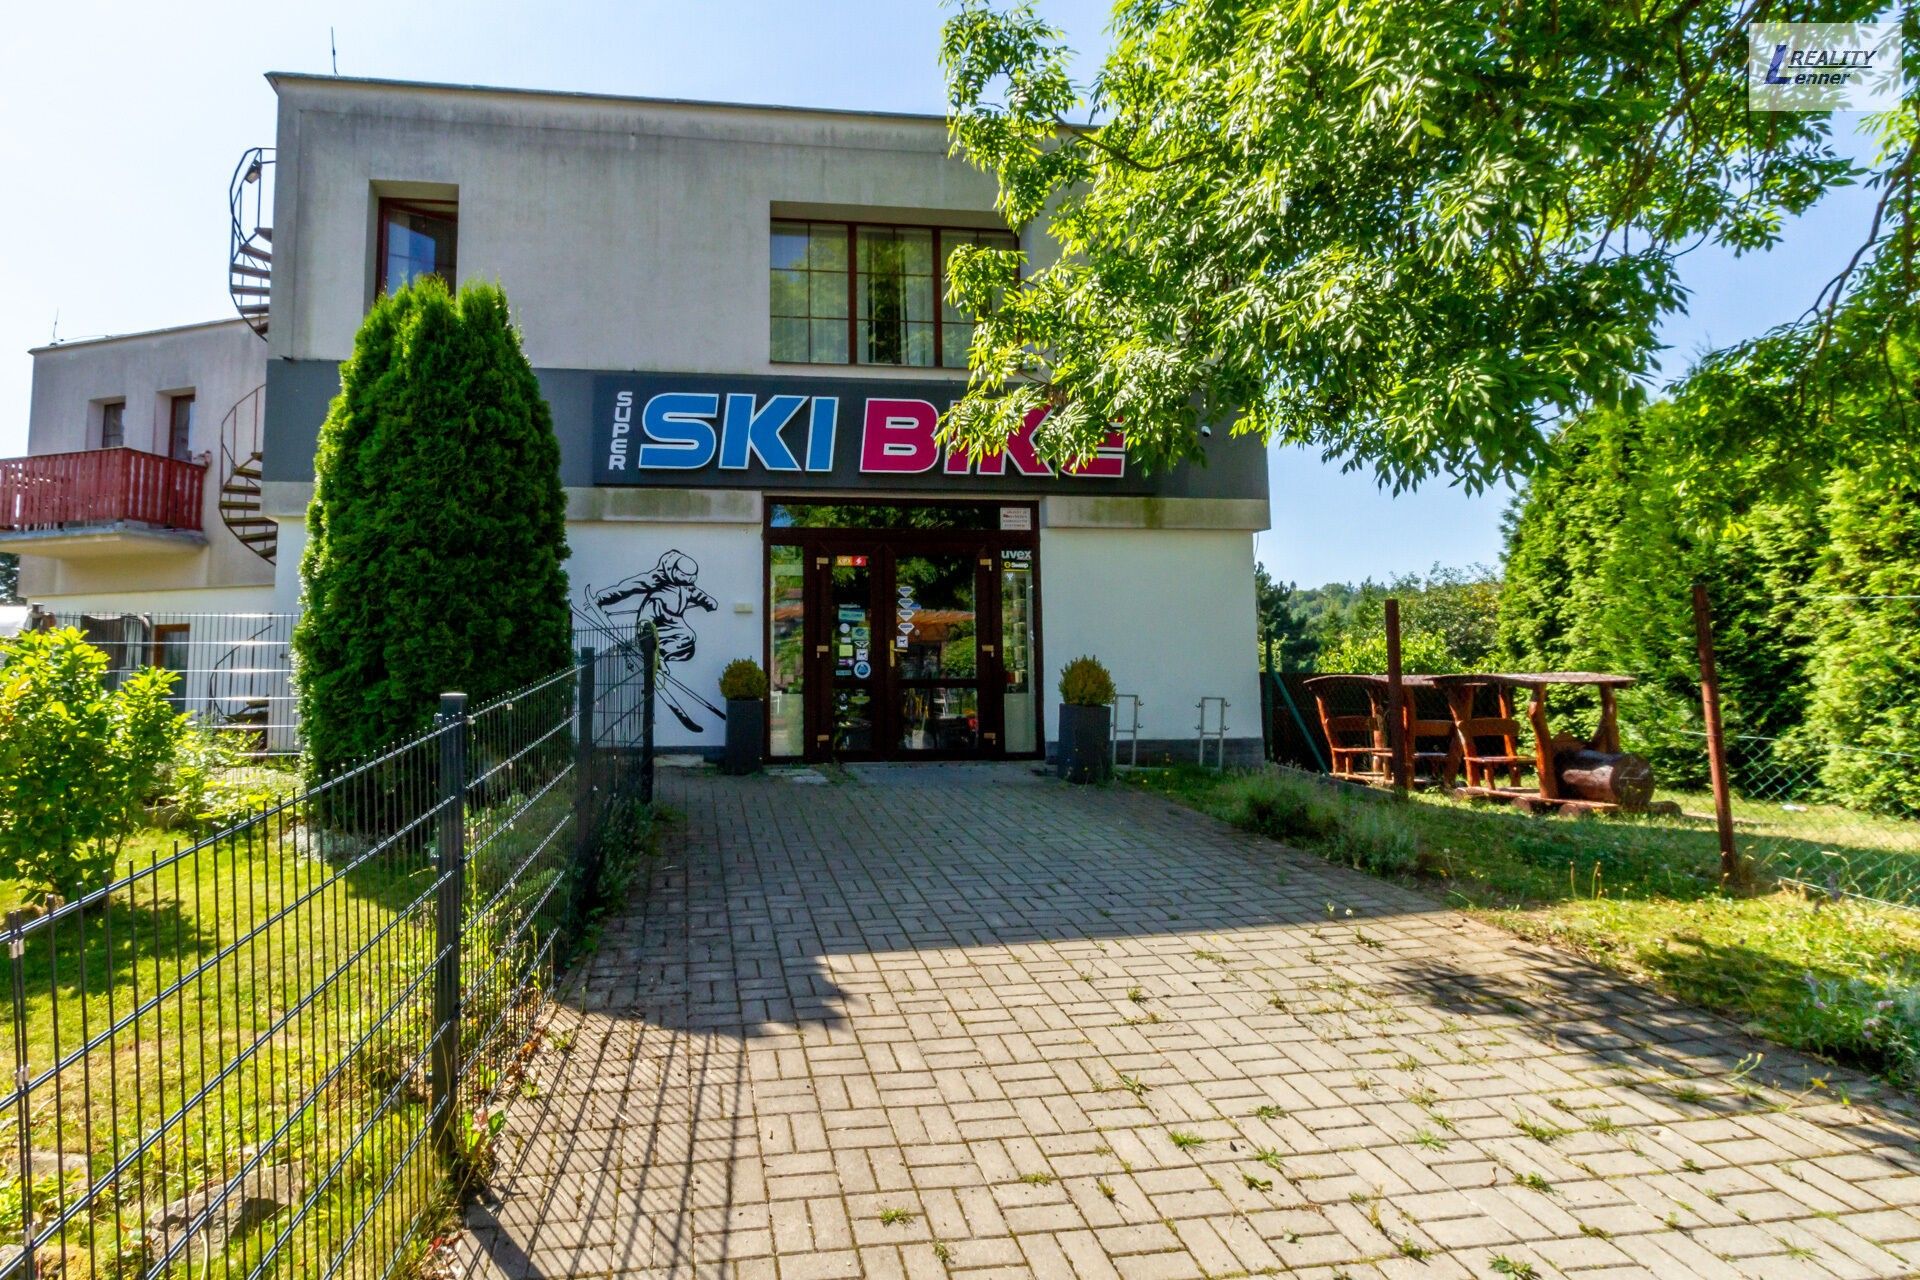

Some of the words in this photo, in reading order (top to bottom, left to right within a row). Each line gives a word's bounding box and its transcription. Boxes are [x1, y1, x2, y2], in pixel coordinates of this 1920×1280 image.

[608, 390, 633, 470] SUPER
[638, 392, 840, 472] SKI
[1001, 550, 1032, 560] uvex
